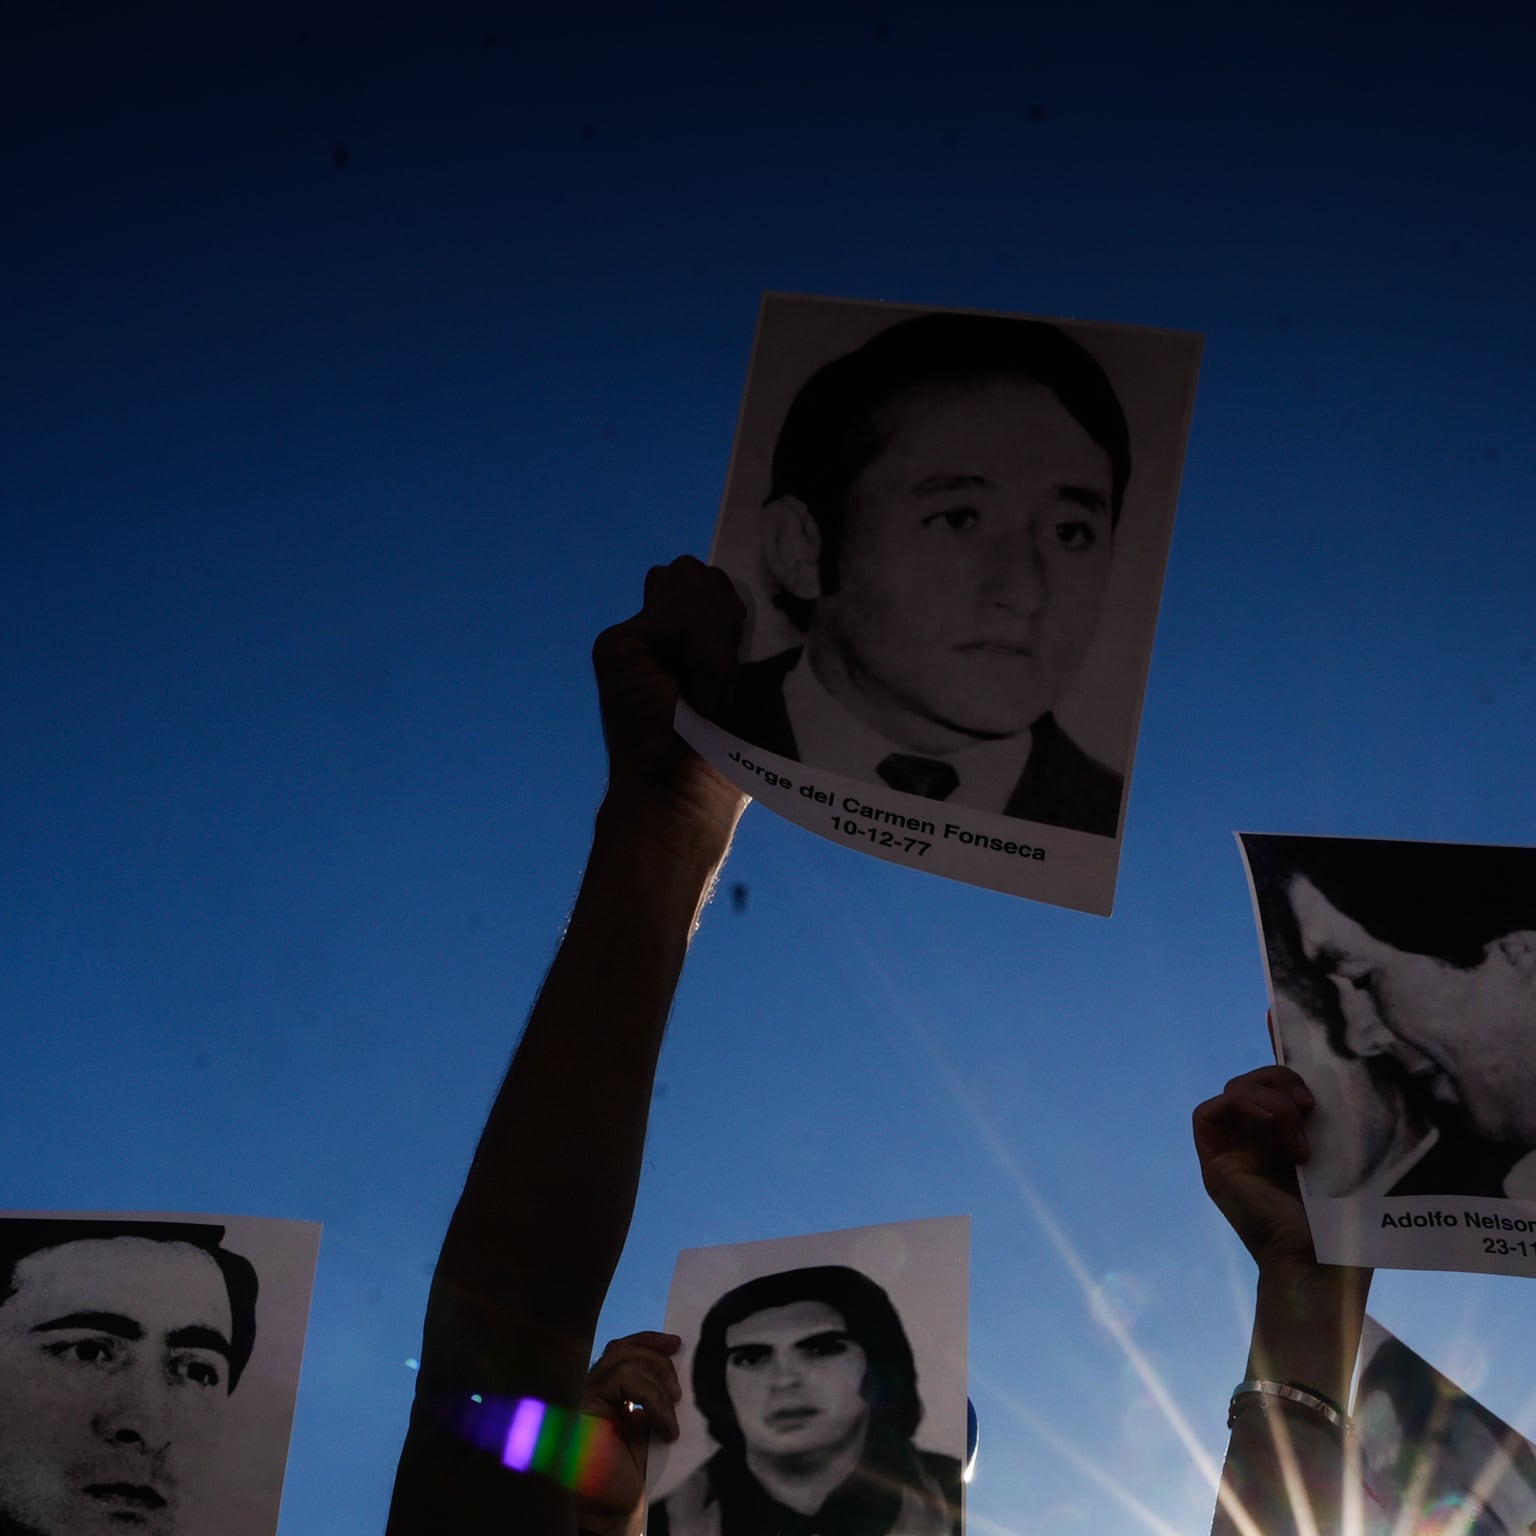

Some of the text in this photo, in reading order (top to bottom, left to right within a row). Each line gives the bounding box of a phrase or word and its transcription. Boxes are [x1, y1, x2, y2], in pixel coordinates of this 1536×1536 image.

[728, 751, 1047, 861] Jorge del Carmen Fonseca
[830, 815, 932, 857] 10-12-77
[1380, 1211, 1458, 1230] Adolfo
